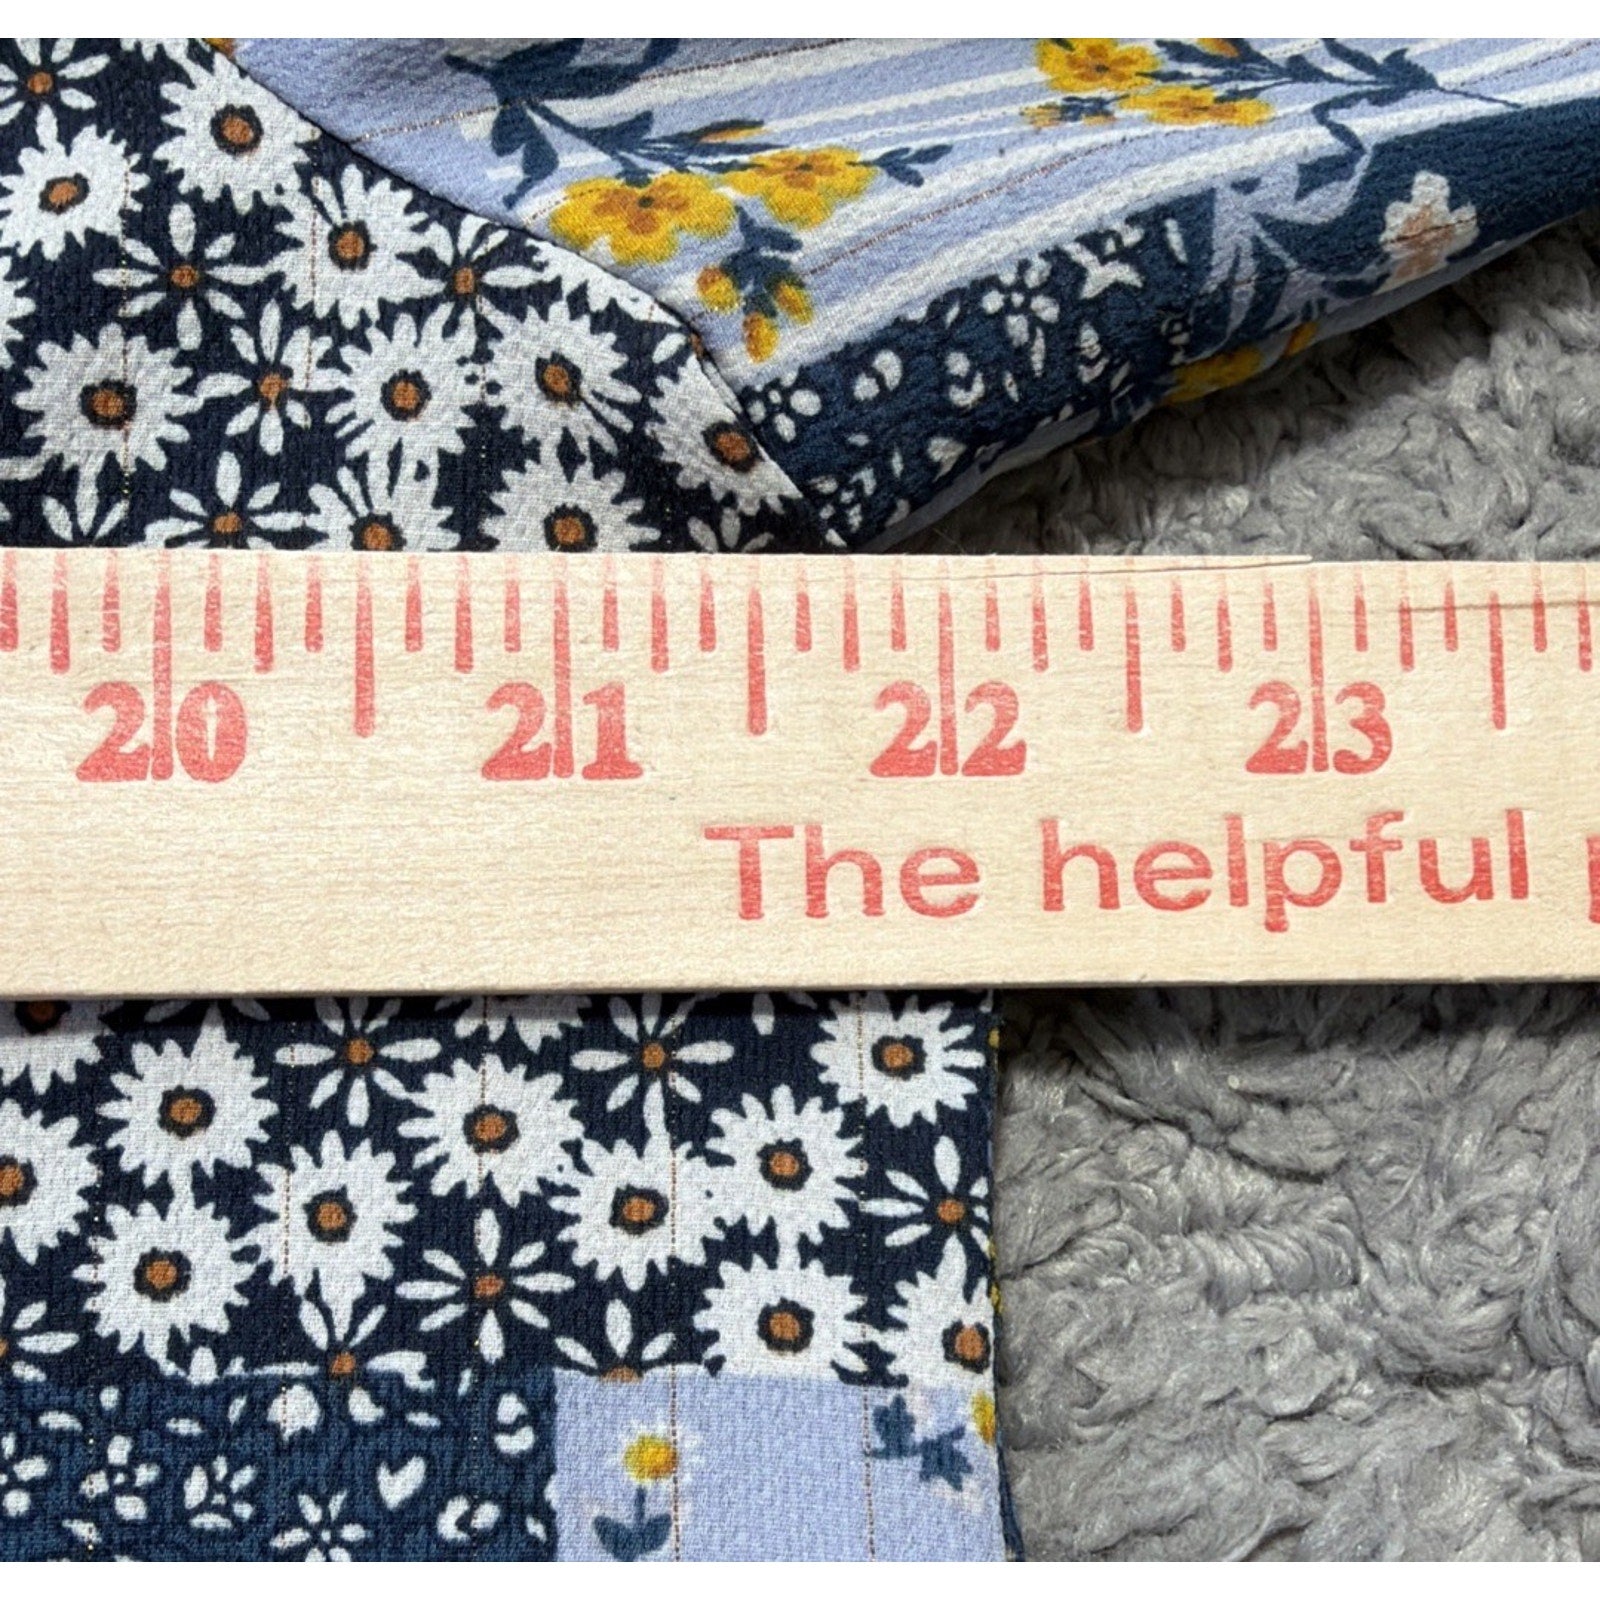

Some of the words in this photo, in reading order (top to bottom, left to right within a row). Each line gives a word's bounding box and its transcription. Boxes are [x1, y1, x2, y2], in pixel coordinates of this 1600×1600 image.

[76, 681, 248, 784] 20
[482, 682, 644, 781] 21
[870, 682, 1027, 778] 22
[1245, 680, 1393, 776] 23
[703, 824, 980, 921] The
[1040, 808, 1530, 934] helpful
